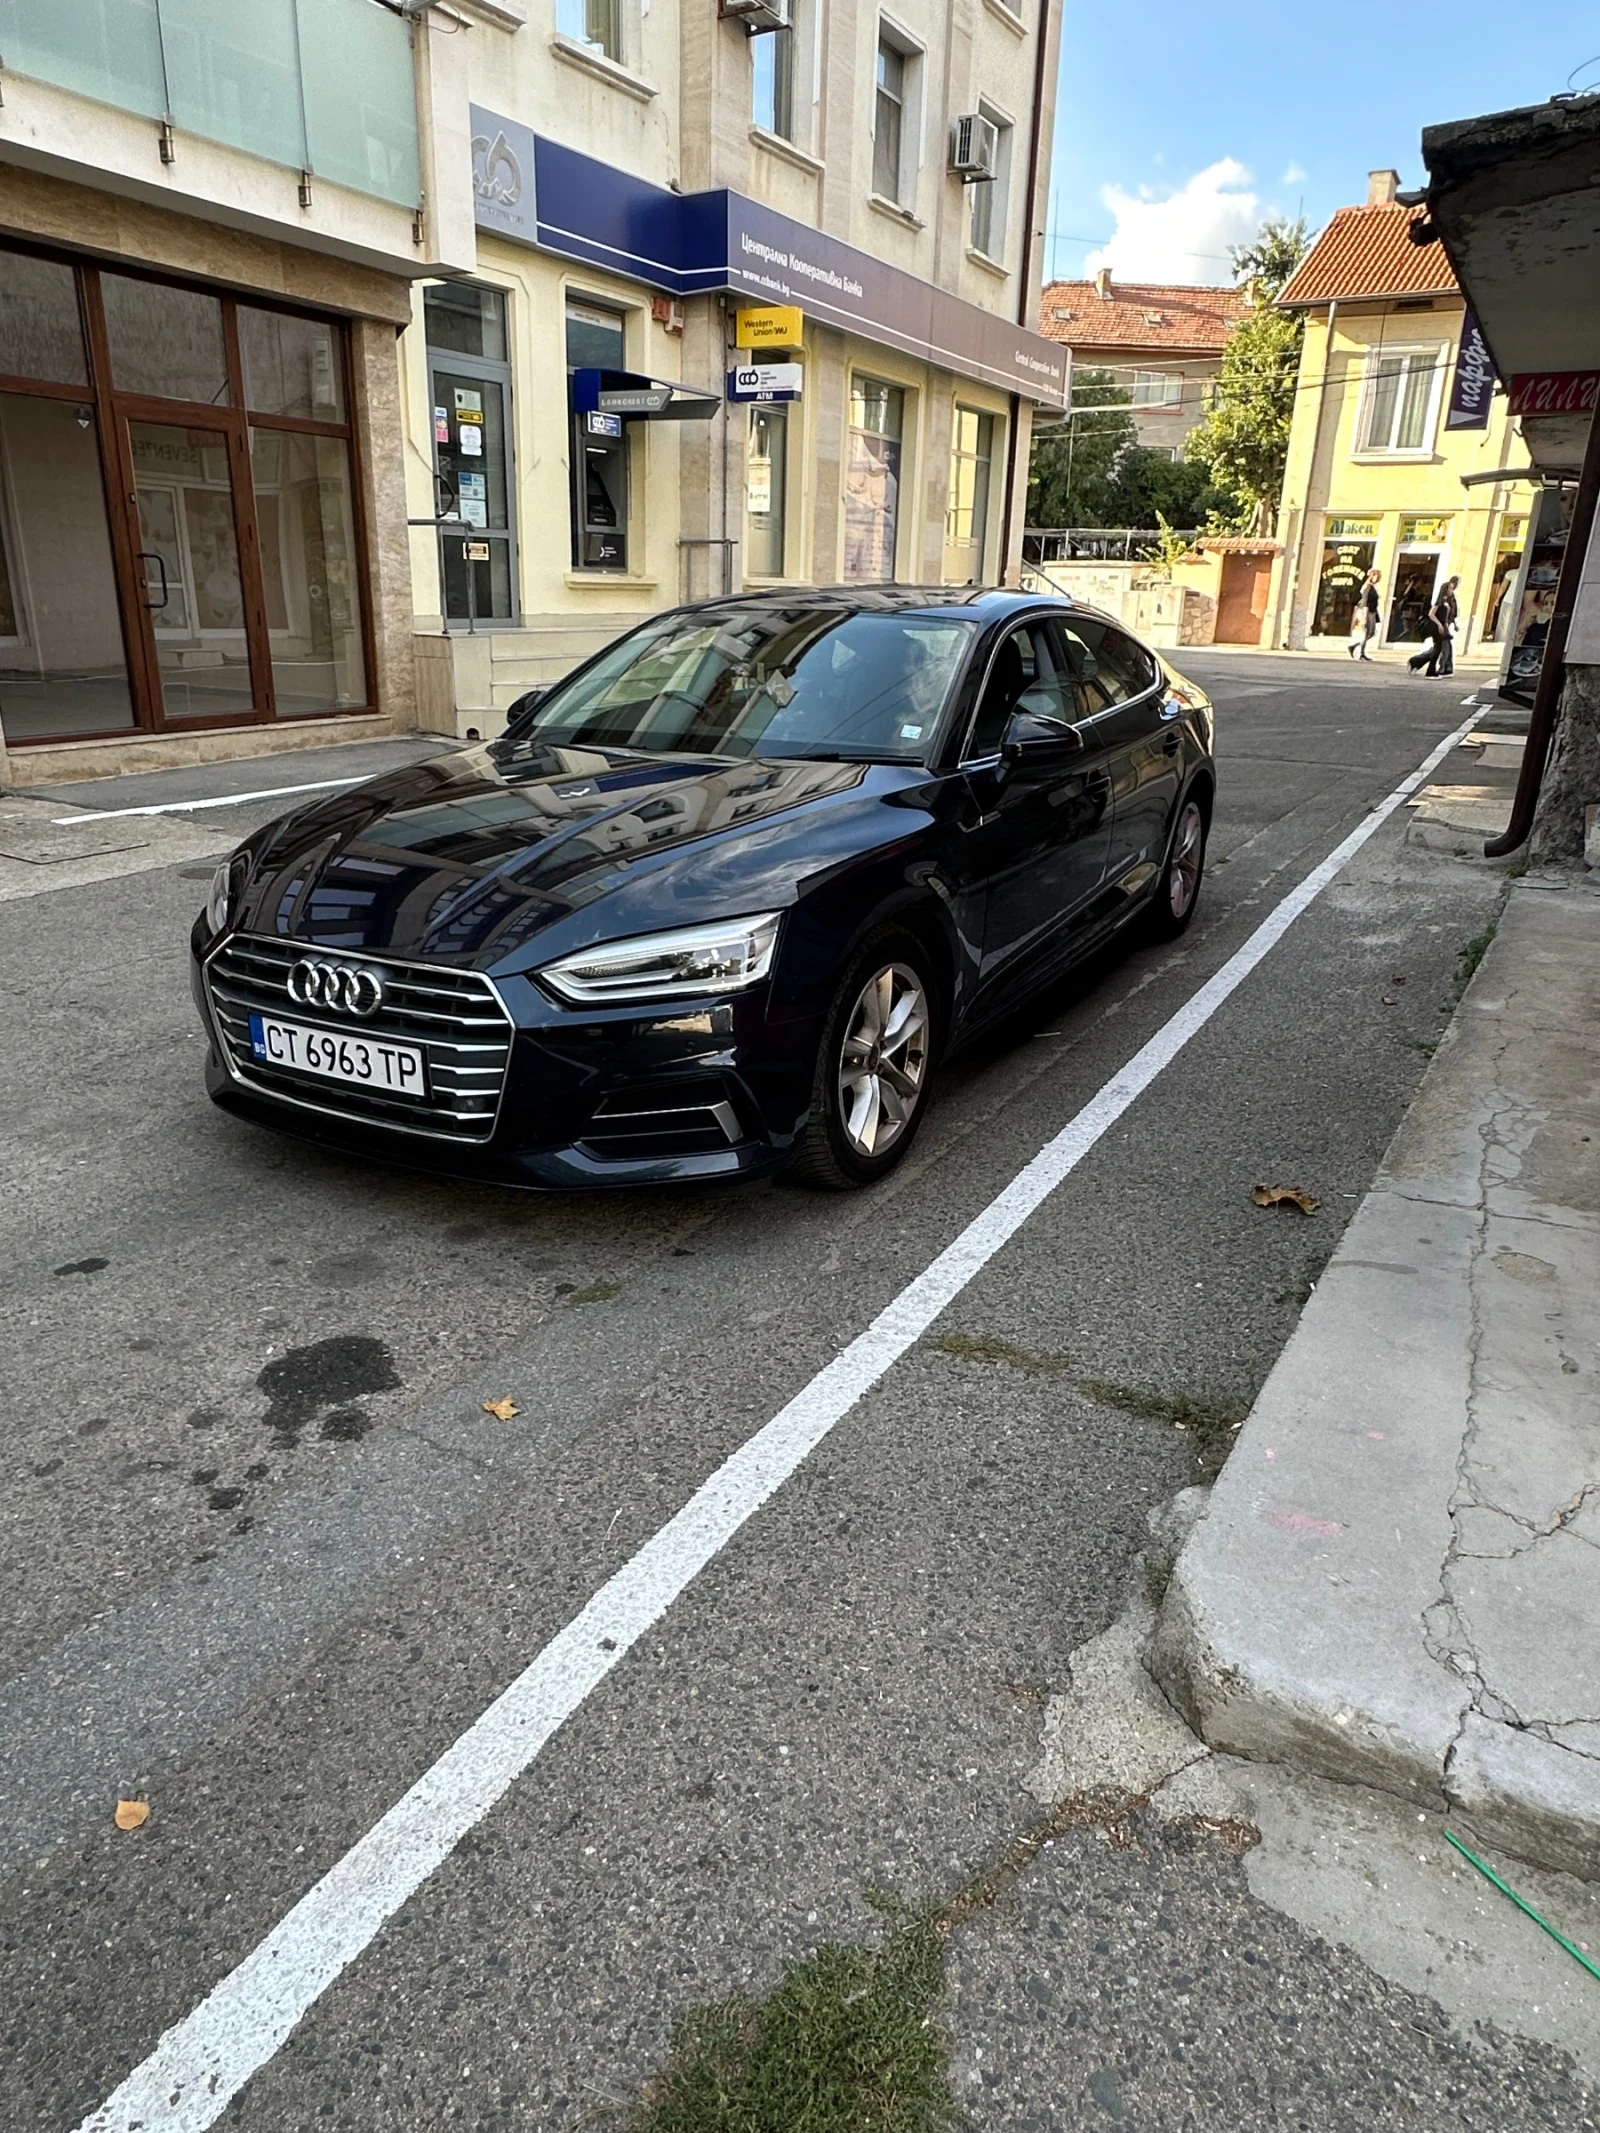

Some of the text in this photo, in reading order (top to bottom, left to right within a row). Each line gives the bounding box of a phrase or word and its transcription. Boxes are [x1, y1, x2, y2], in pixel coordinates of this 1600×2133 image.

[742, 232, 863, 298] Централна Кооперативна Банка
[744, 320, 773, 328] Western
[753, 328, 773, 336] Union
[756, 392, 774, 401] ATM
[254, 1042, 266, 1055] BG
[267, 1025, 417, 1087] CT 6963 TP
